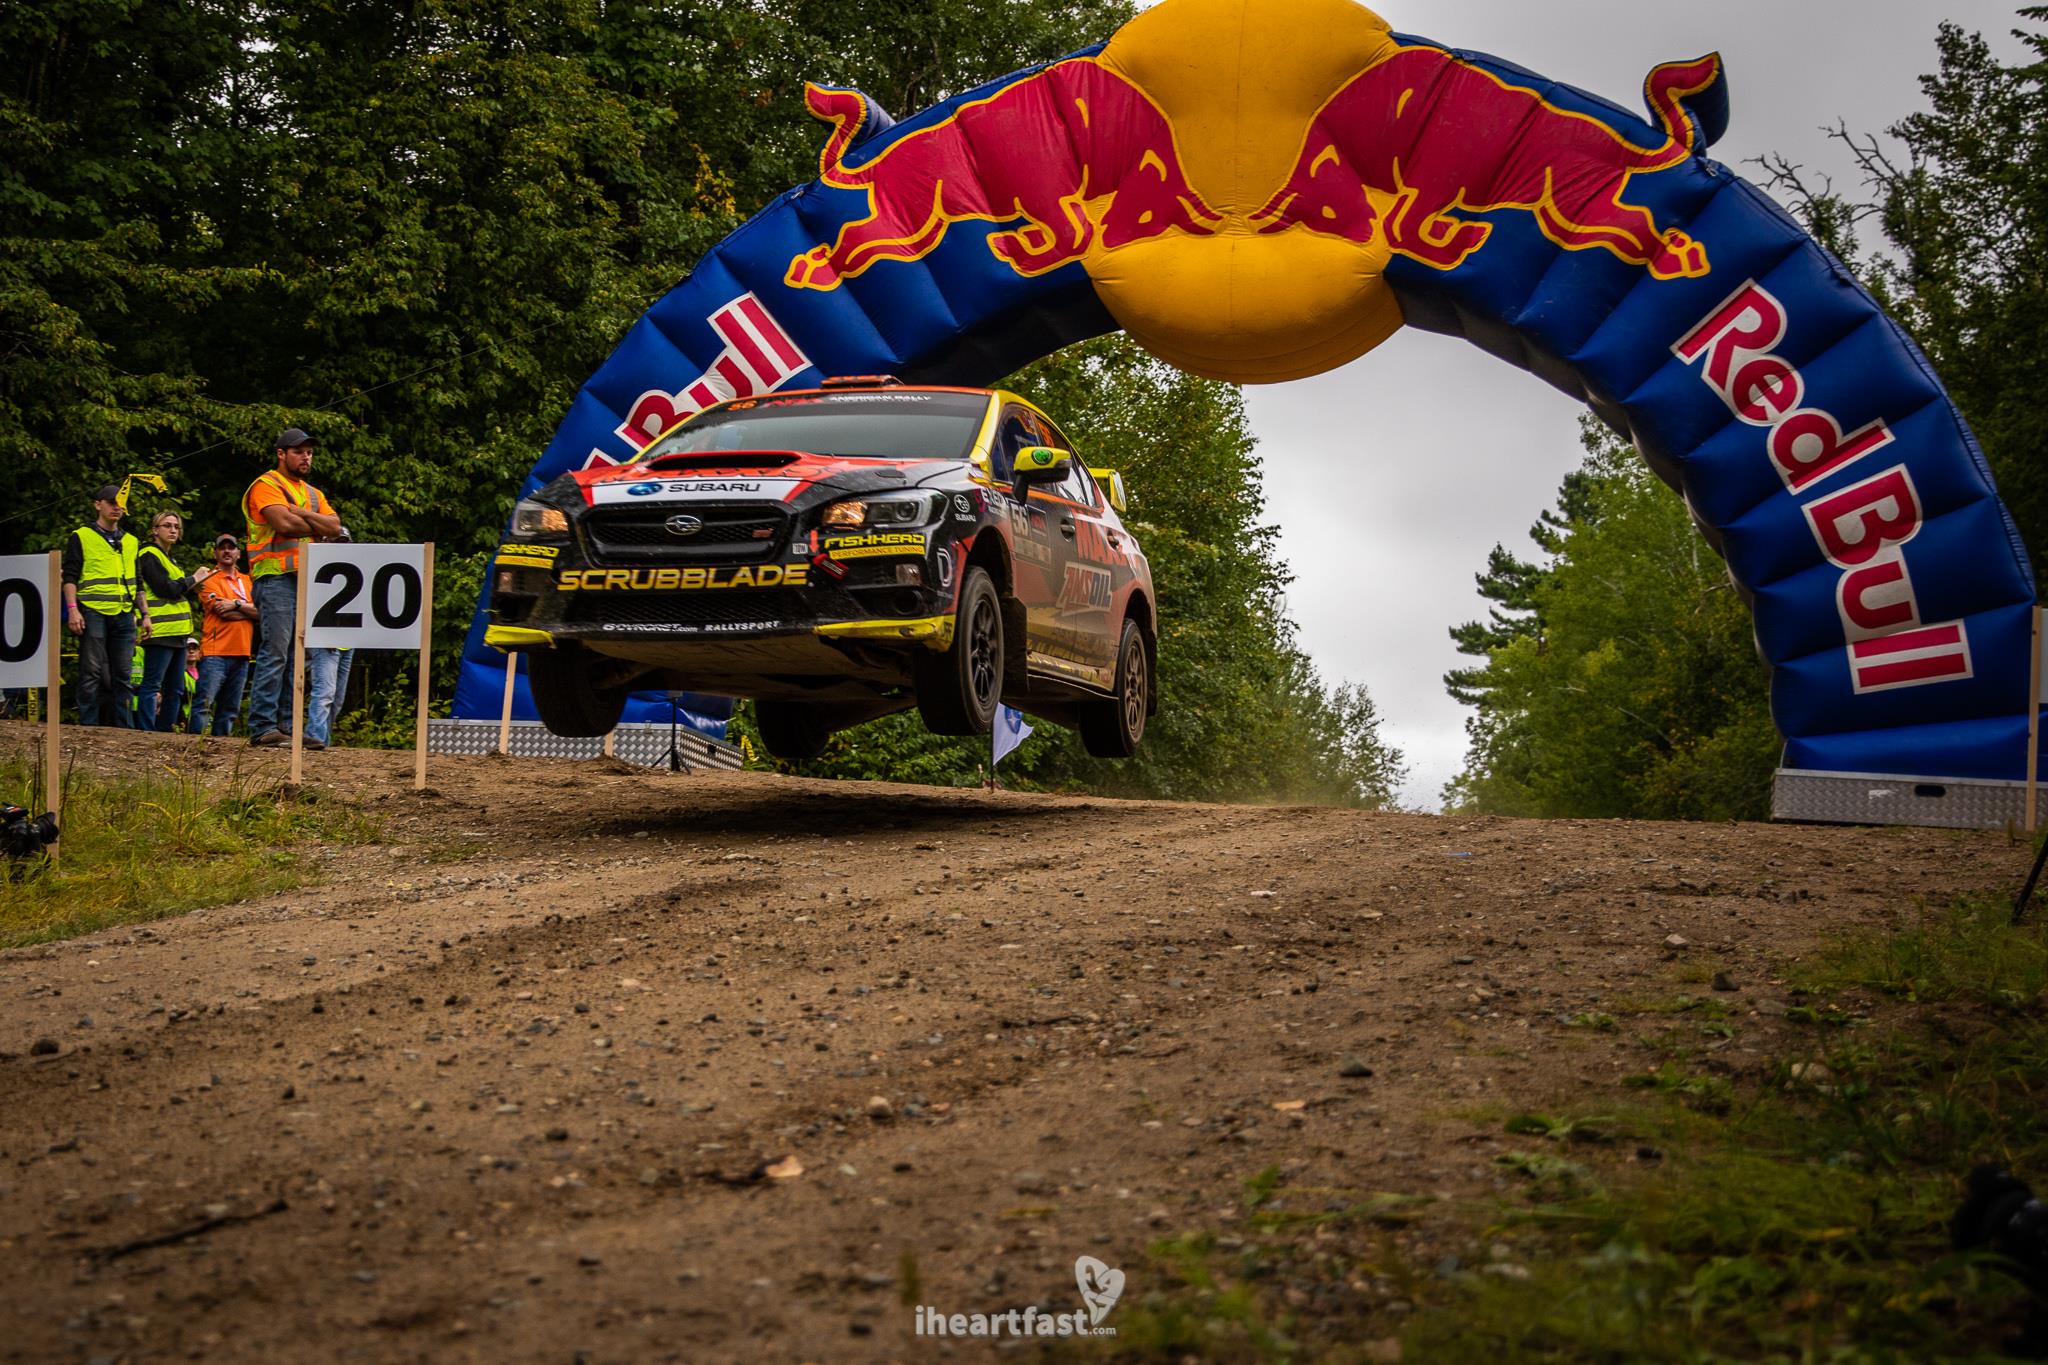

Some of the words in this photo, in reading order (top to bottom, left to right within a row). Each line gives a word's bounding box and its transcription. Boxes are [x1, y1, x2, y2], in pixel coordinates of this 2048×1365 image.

[668, 482, 762, 493] SUBARU
[1669, 278, 1896, 495] Red
[1801, 463, 1974, 694] Bull
[954, 513, 977, 522] SUBARU
[1011, 503, 1029, 536] 56
[831, 547, 893, 558] PERFORMANCE
[894, 546, 923, 554] TUNING
[557, 563, 811, 591] SCRUBBLADE
[312, 562, 422, 629] 20
[704, 620, 780, 631] RALLYSPORT
